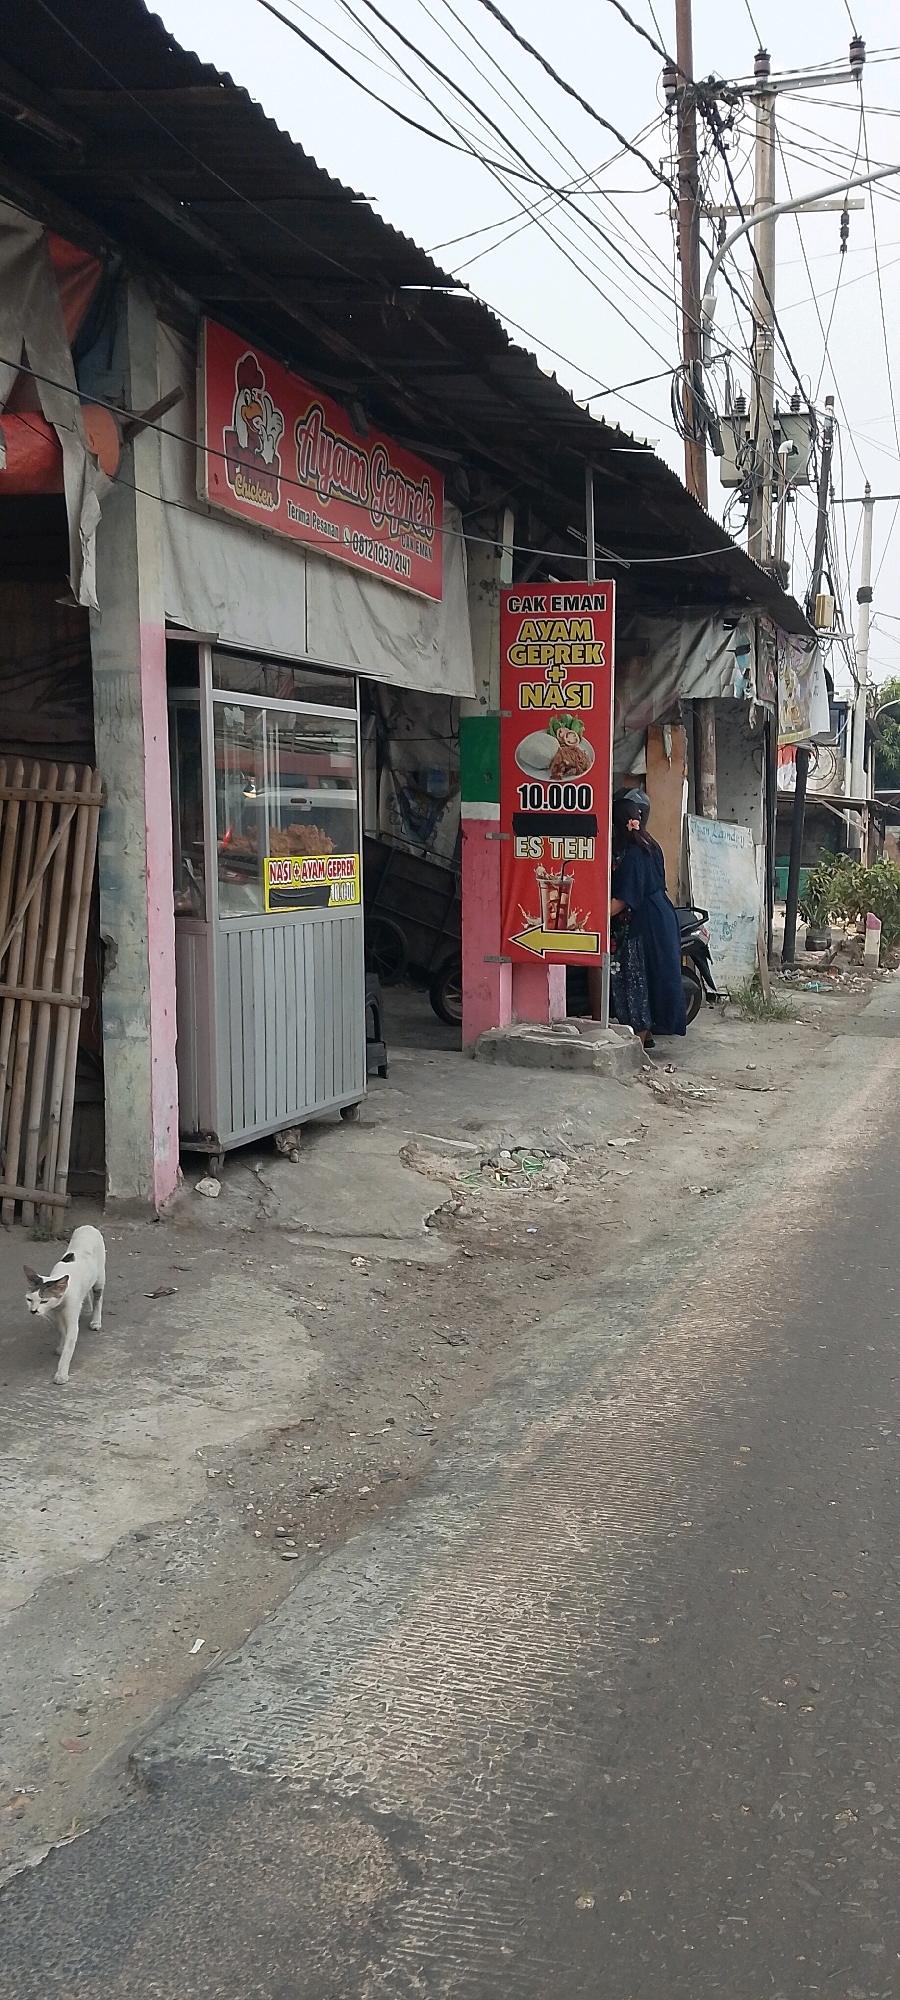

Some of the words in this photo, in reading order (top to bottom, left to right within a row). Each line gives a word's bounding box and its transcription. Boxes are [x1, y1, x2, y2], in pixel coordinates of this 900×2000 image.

[295, 403, 369, 504] Ayam
[371, 444, 434, 540] Geprek
[235, 473, 273, 507] Chicken
[287, 499, 310, 527] Terima
[312, 510, 339, 540] Pesanan
[352, 531, 374, 560] 0812
[375, 542, 394, 569] 1037
[415, 541, 433, 562] EMAN
[508, 596, 546, 612] CAK
[552, 595, 606, 612] EMAN
[518, 618, 594, 642] AYAM
[508, 642, 605, 666] GEPREK
[547, 665, 566, 684] +
[520, 684, 593, 709] NASI
[518, 783, 593, 811] 10.000
[515, 836, 543, 859] ES
[550, 837, 594, 860] TEH
[269, 860, 292, 884] NASI
[293, 862, 300, 880] +
[301, 858, 325, 881] AYAM
[326, 856, 355, 879] GEPREK
